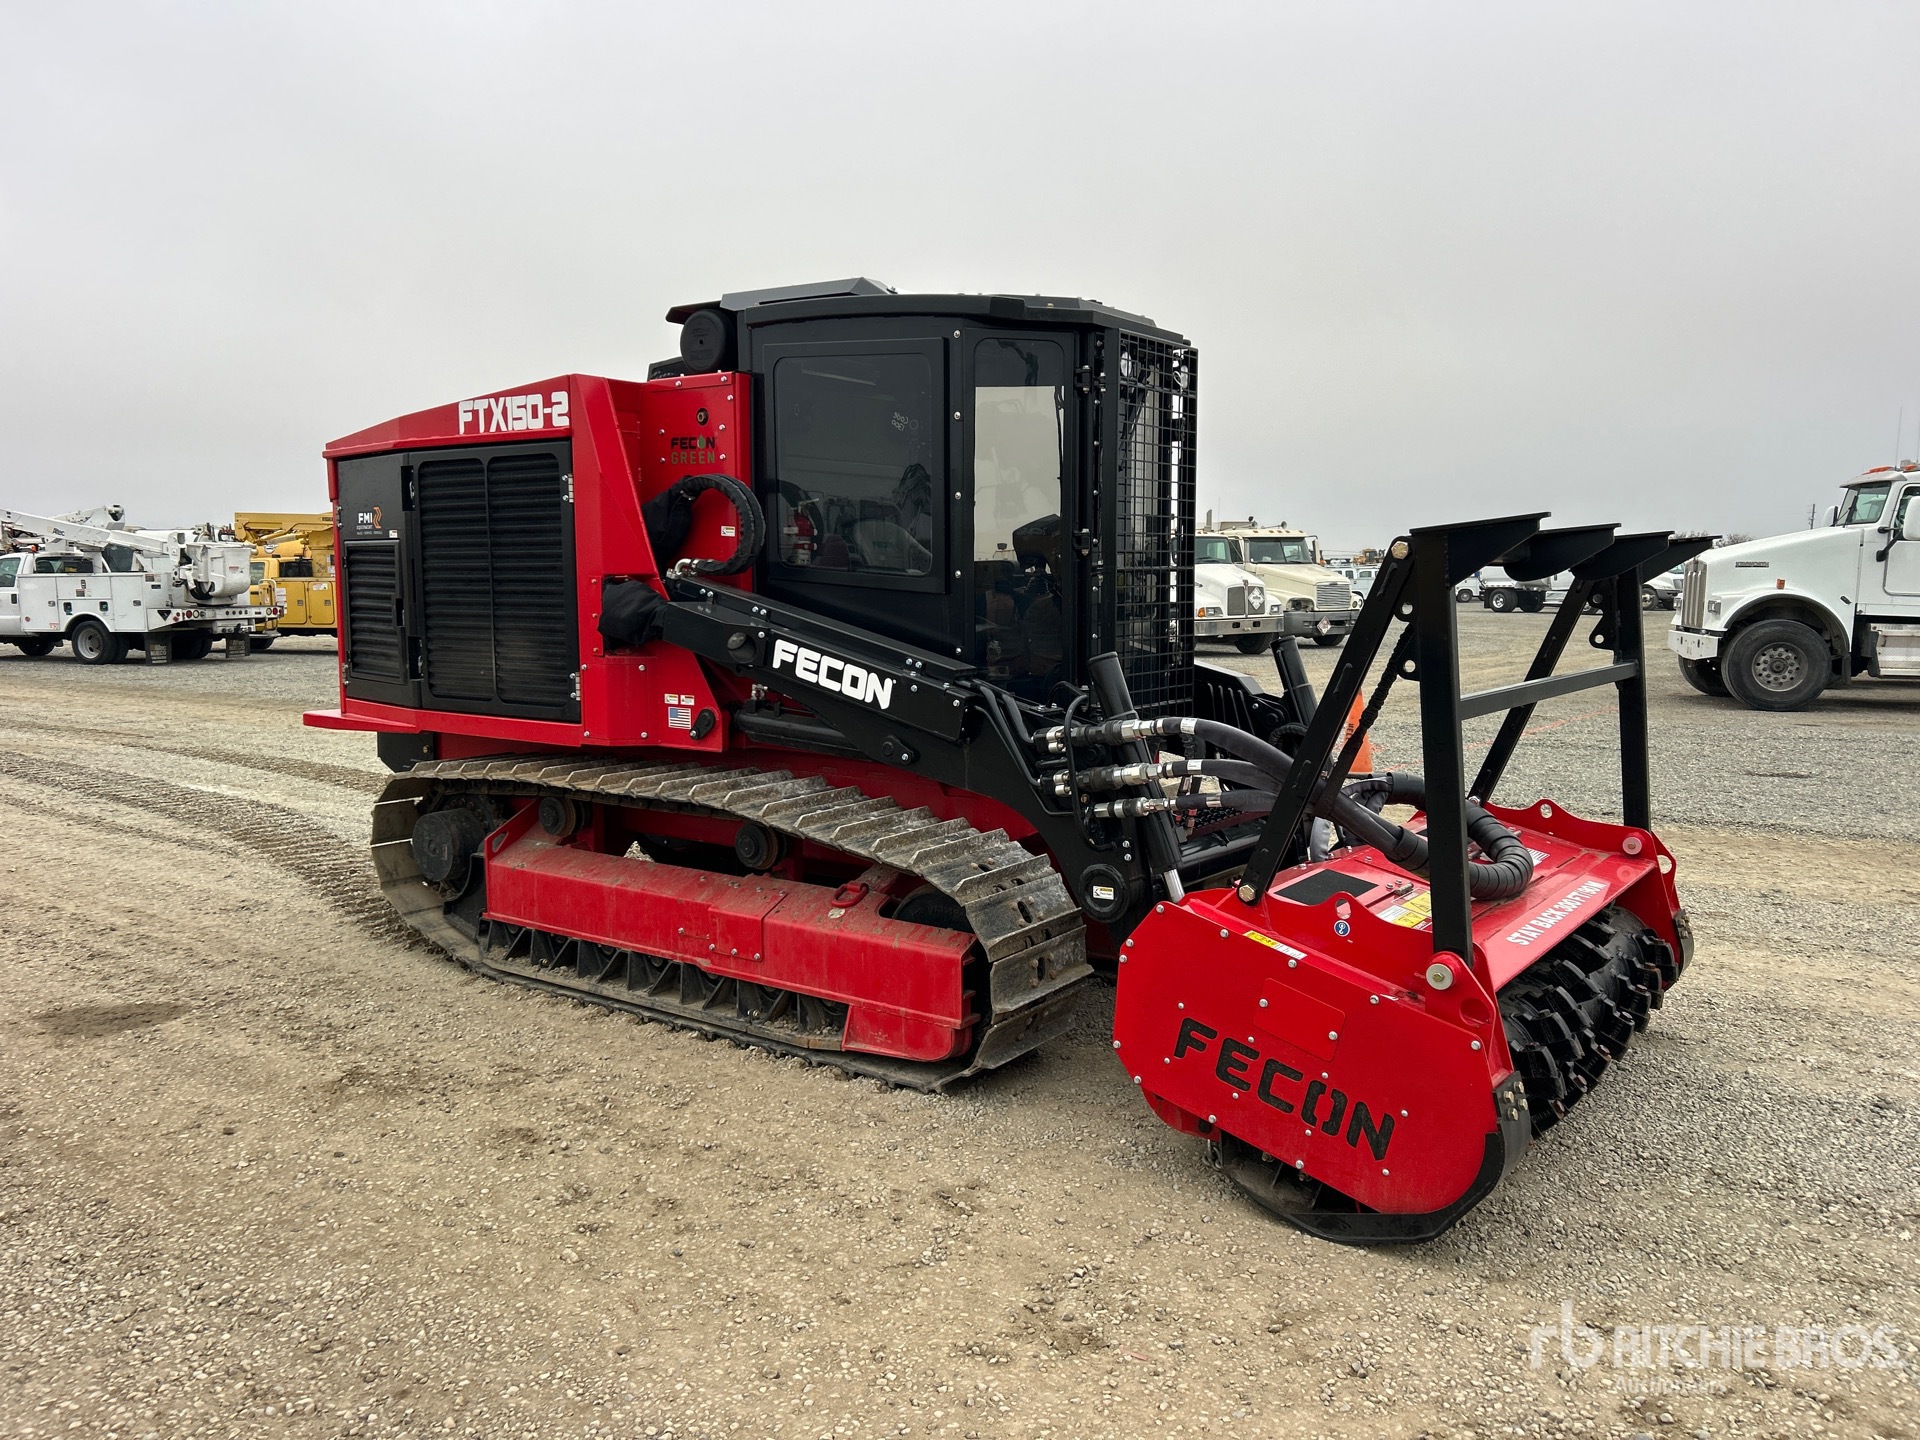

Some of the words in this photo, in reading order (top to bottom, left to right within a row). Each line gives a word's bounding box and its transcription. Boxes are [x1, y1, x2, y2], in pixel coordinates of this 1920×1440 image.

[458, 390, 570, 435] FTX150-2
[671, 434, 716, 449] FECON
[671, 451, 715, 465] GREEN
[358, 512, 373, 524] FMI
[772, 638, 894, 710] FECON
[1506, 924, 1545, 946] STAY
[1530, 908, 1569, 929] BACK
[1173, 1017, 1396, 1162] FECON
